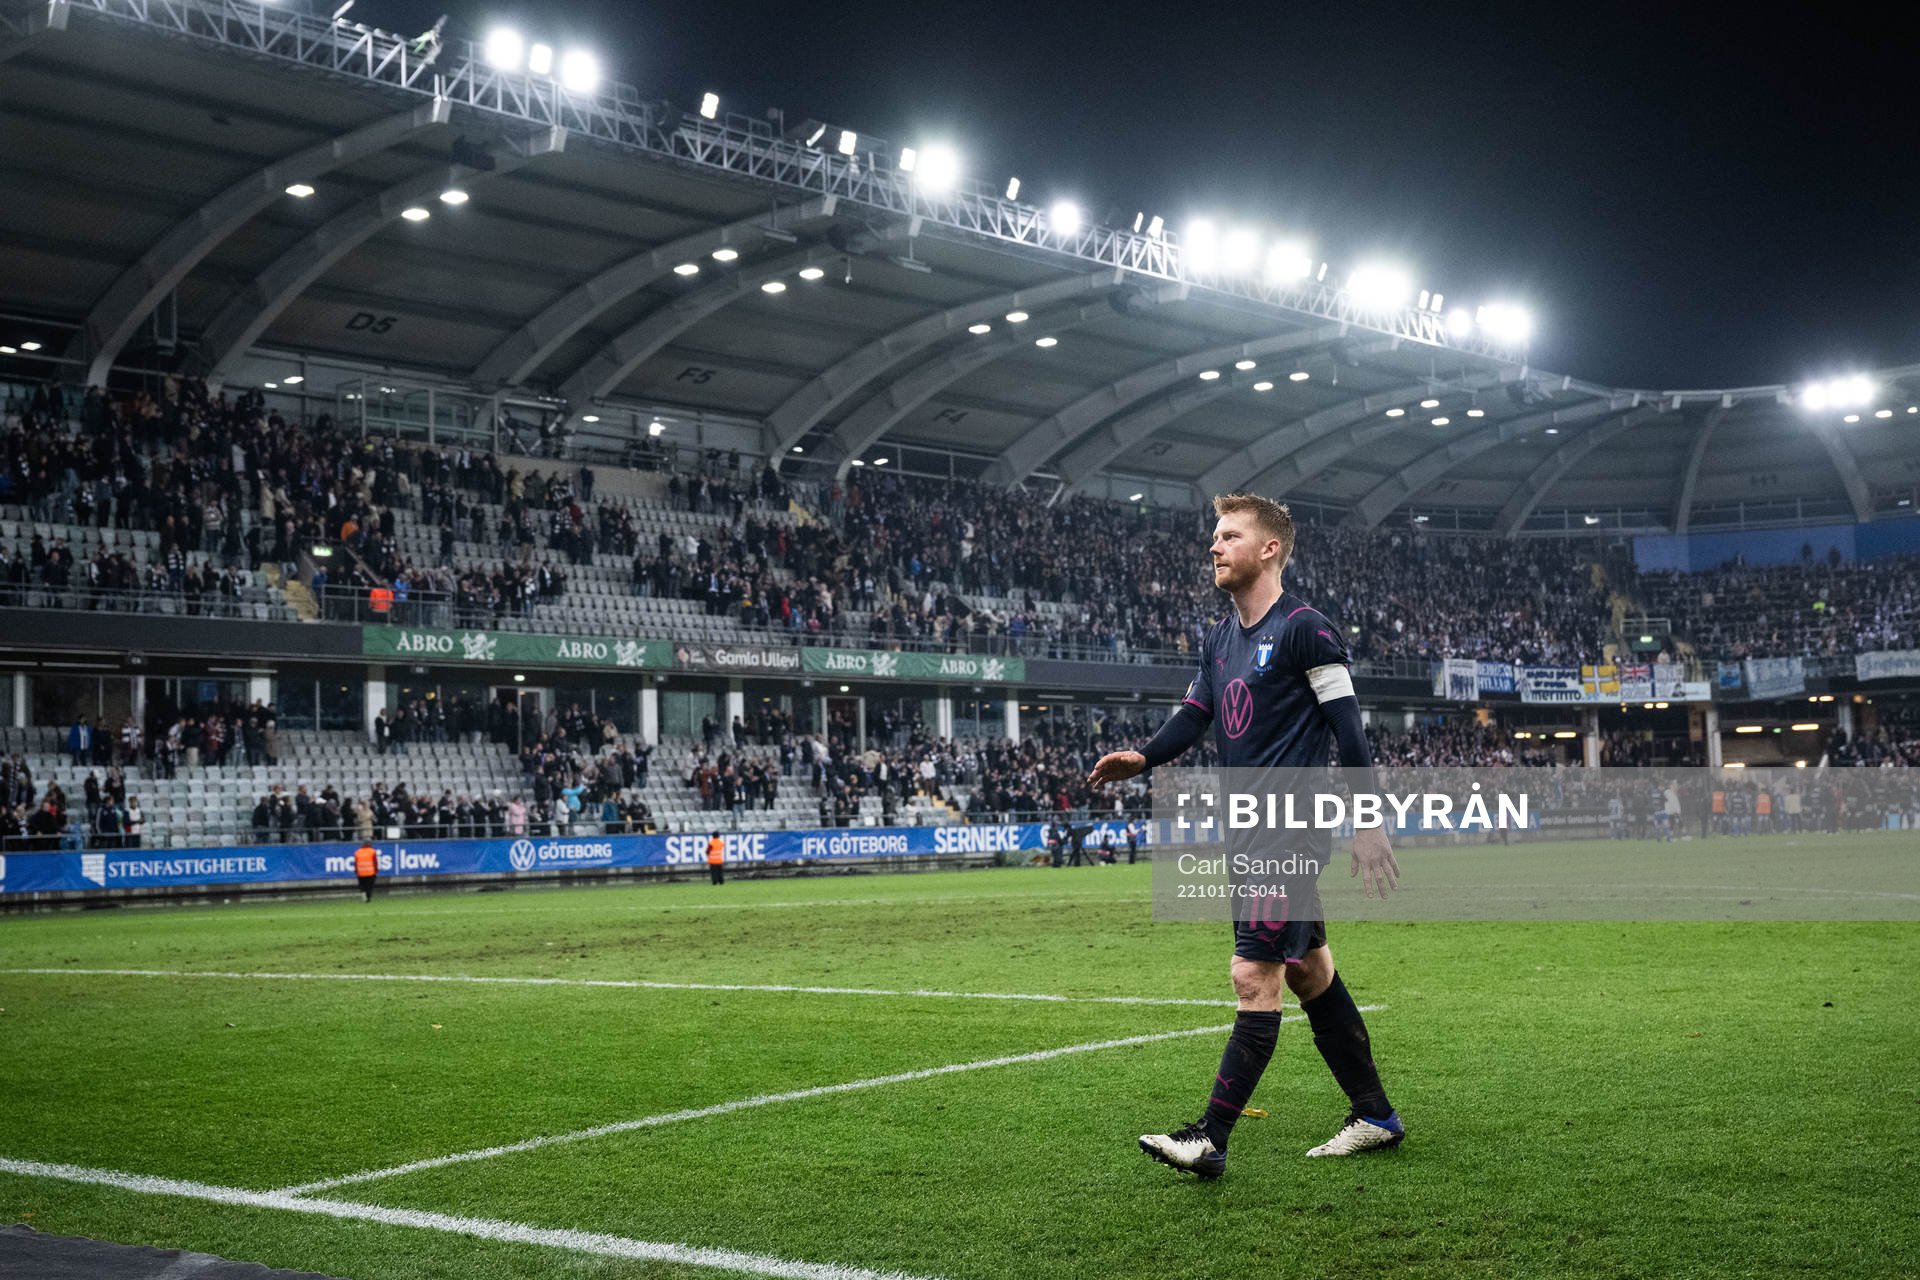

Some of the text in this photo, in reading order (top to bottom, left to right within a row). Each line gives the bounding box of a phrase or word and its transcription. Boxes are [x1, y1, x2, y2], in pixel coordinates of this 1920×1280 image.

[345, 311, 398, 335] D5
[675, 366, 717, 386] F5
[397, 630, 453, 653] ÅBRO
[557, 638, 608, 660] ÅBRO
[715, 649, 760, 668] Gamla
[762, 651, 800, 668] Ullevi
[825, 652, 867, 671] ÅBRO
[939, 657, 977, 676] ÅBRO
[666, 833, 766, 864] SEREKE
[802, 833, 908, 856] IFK GÖTEBORG
[934, 825, 1021, 853] SERNEKE
[325, 848, 440, 873] mois law.
[538, 842, 612, 861] GÖTEBORG
[108, 855, 267, 879] STENFASTIGHETER
[1248, 892, 1290, 931] 10
